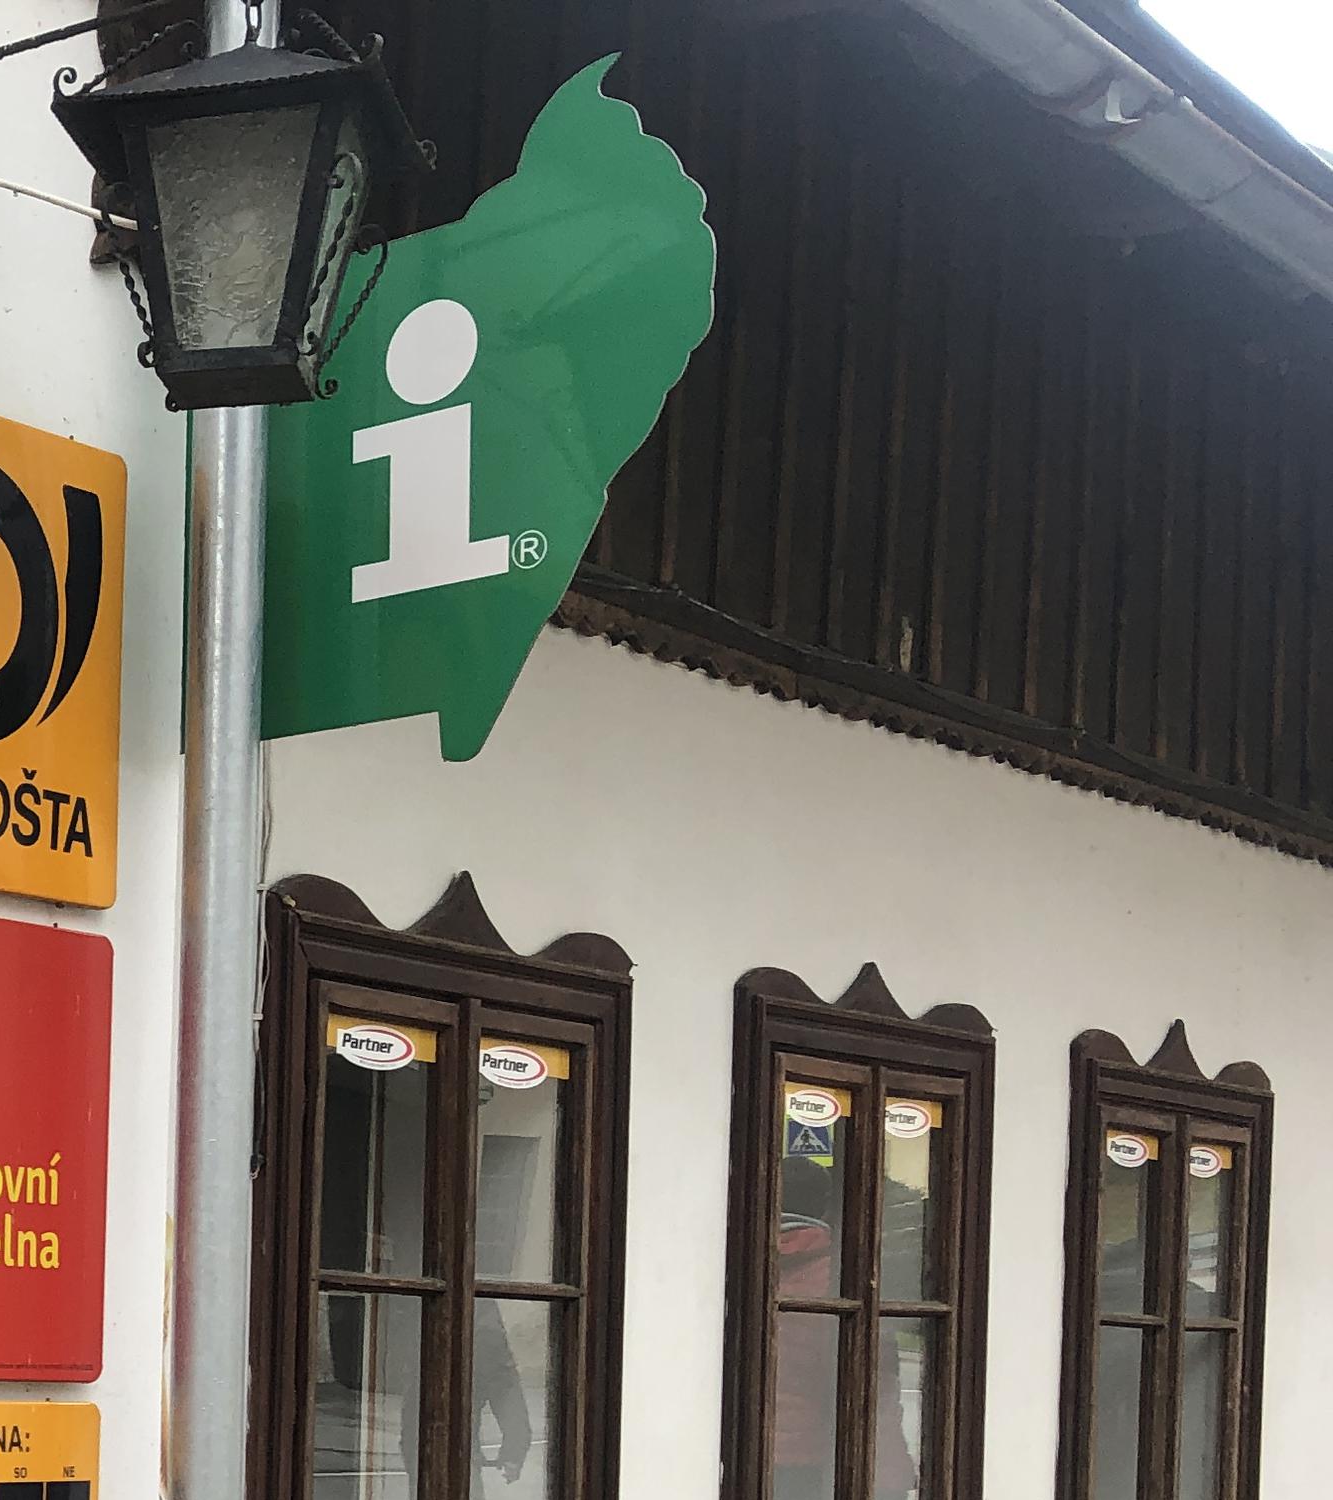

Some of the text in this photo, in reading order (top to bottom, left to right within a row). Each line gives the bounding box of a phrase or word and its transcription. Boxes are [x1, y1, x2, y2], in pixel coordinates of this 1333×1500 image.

[342, 1033, 394, 1054] Partner
[482, 1053, 529, 1073] Partner
[789, 1096, 827, 1114] Partner
[14, 1467, 27, 1479] SO
[63, 1466, 75, 1478] NE
